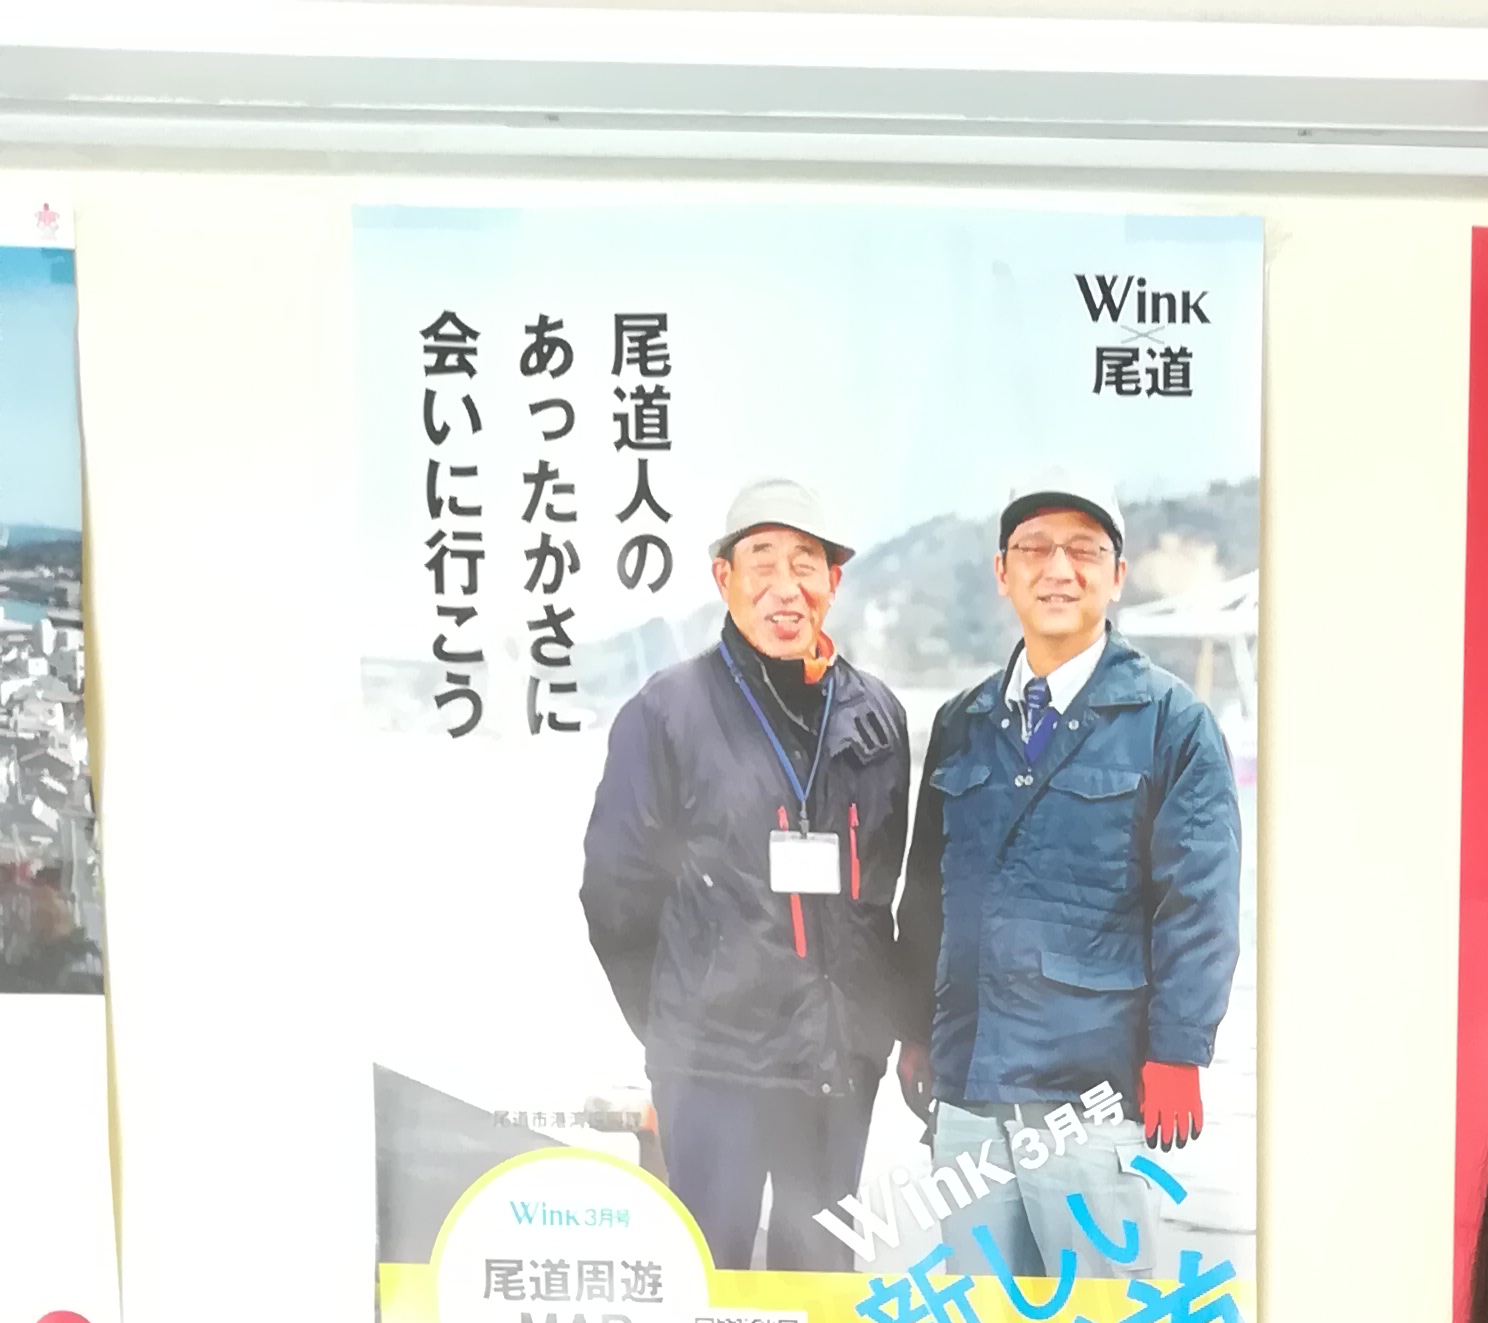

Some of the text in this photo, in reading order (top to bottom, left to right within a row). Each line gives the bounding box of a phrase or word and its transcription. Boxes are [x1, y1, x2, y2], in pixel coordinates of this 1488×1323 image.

[1092, 344, 1194, 398] 尾道
[611, 311, 675, 594] 尾道人の
[419, 309, 485, 741] 会いに行こう
[517, 311, 582, 736] あったかさに
[493, 1109, 642, 1131] 尾道市港湾
[1010, 1080, 1125, 1170] 3月号
[584, 1207, 632, 1229] 3月号
[483, 1258, 664, 1304] 尾道周遊
